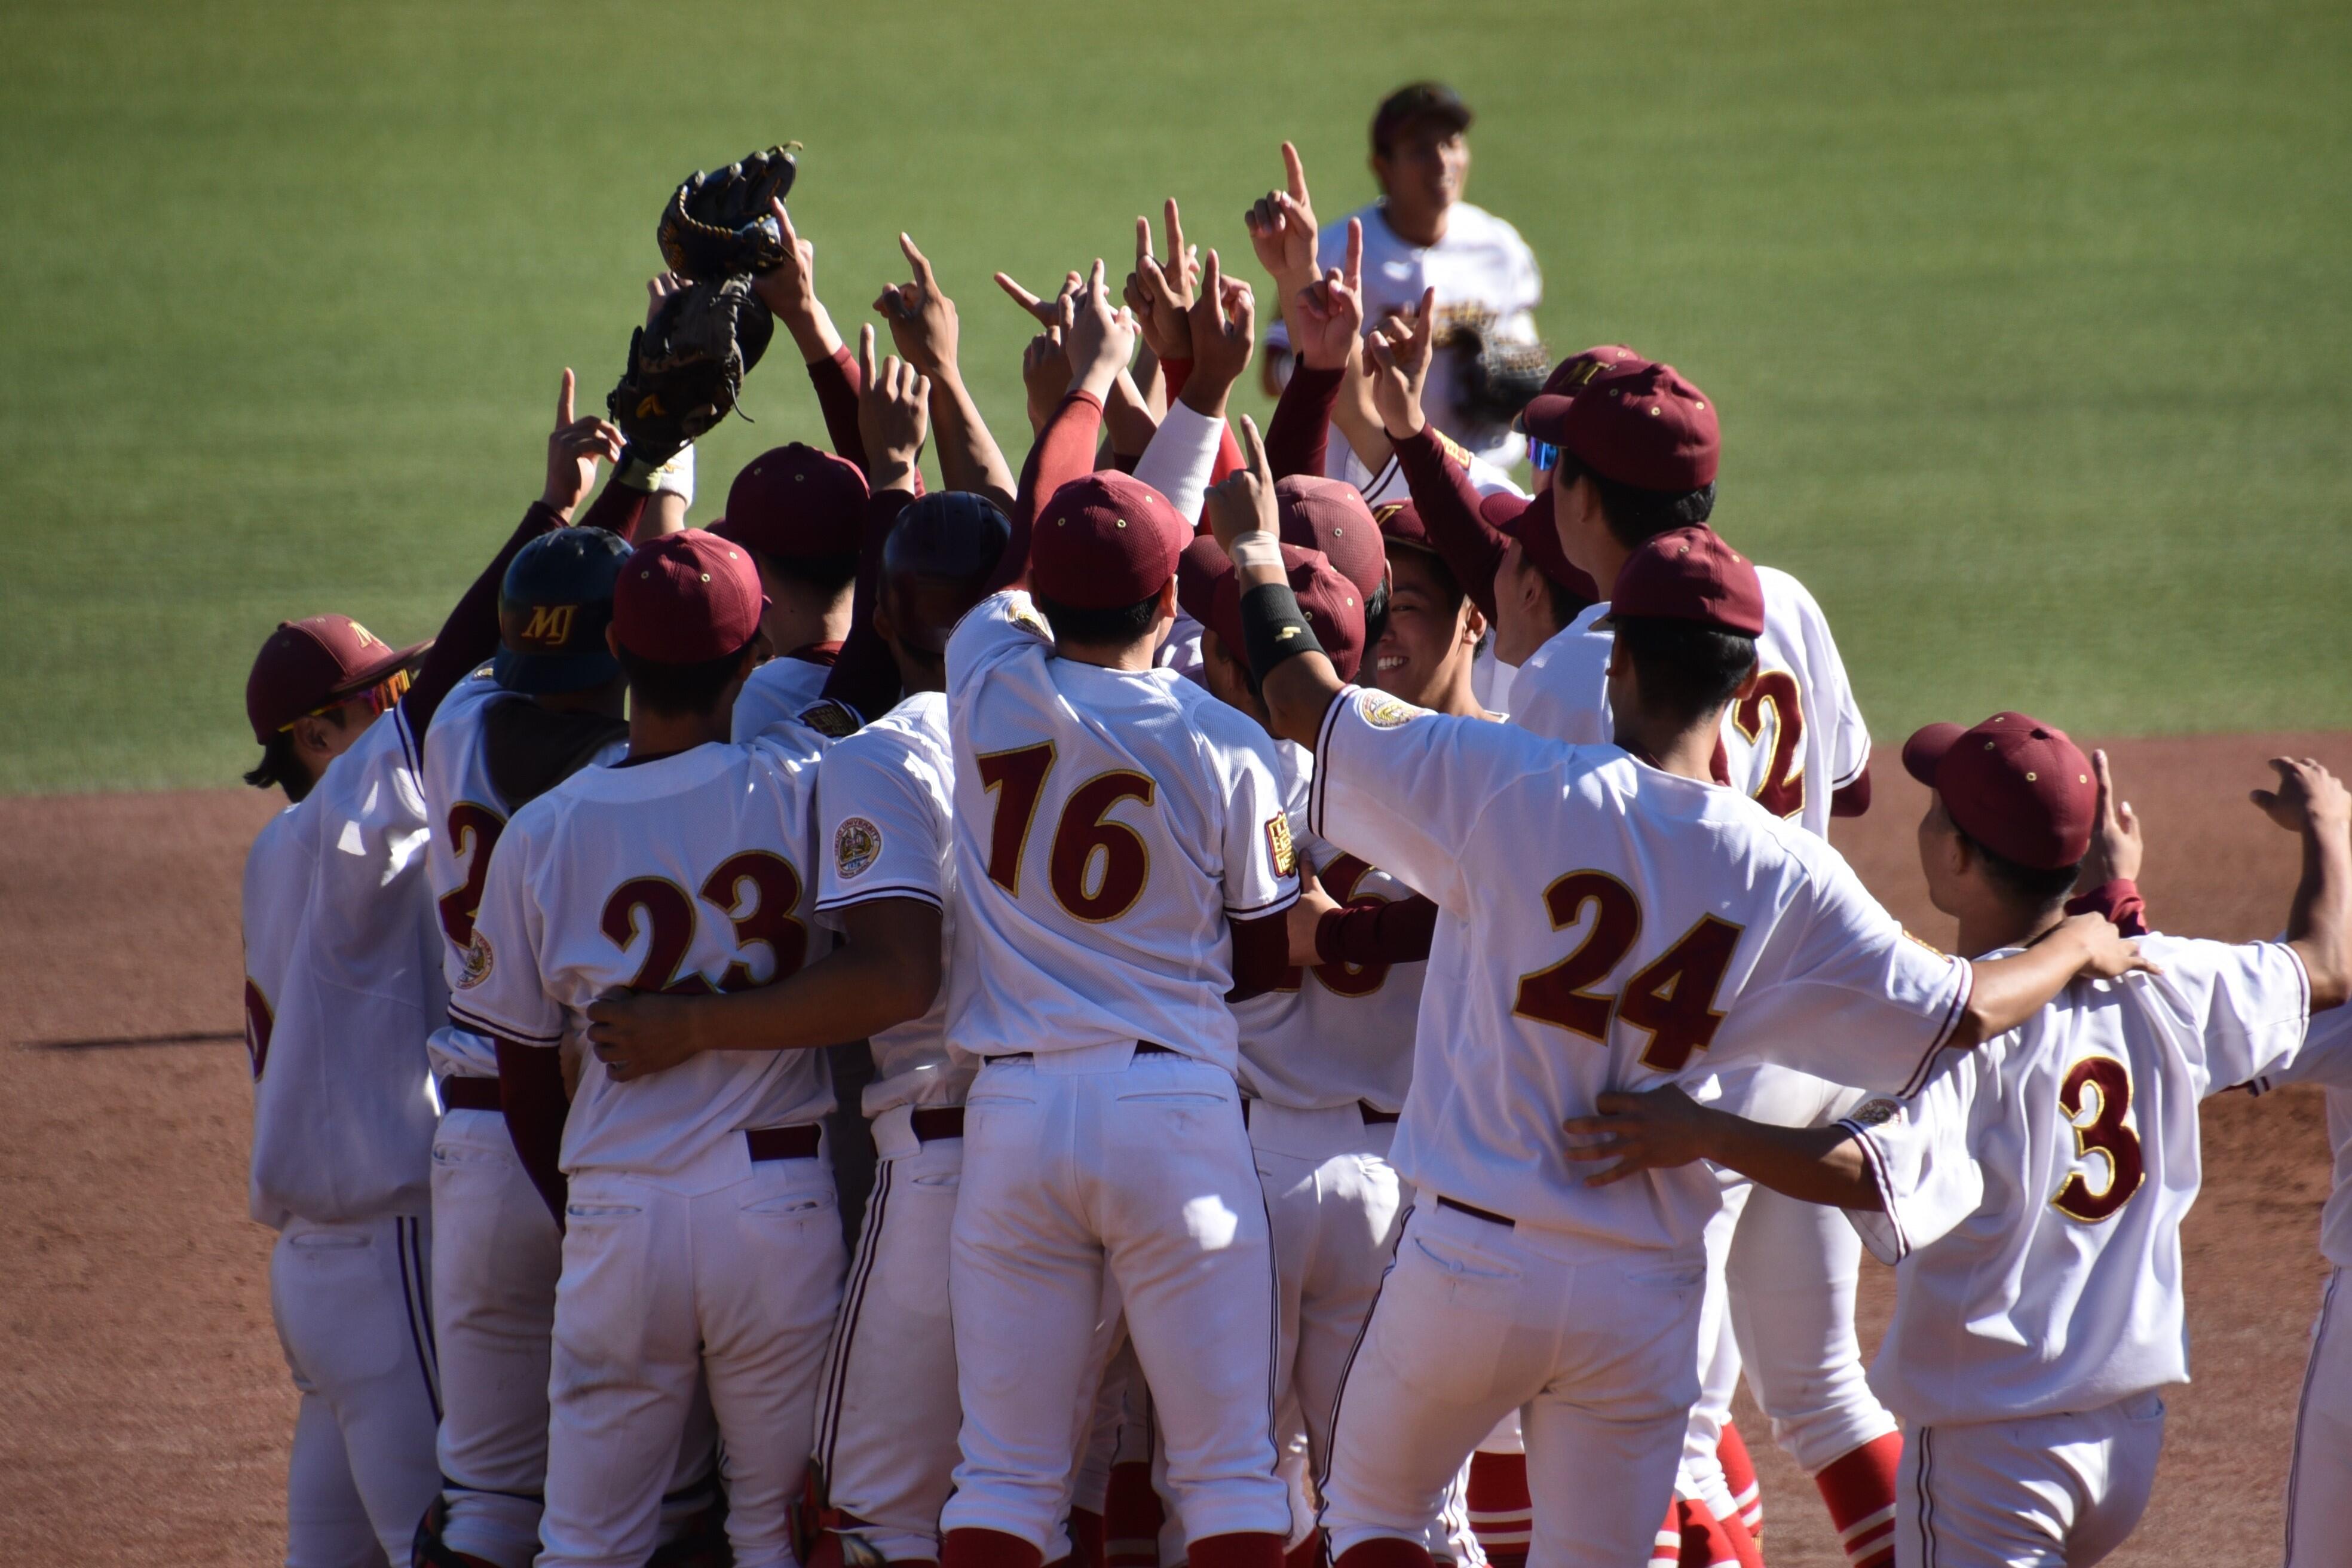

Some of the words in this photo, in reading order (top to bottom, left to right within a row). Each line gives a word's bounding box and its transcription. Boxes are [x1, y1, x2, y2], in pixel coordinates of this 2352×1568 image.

[521, 604, 578, 645] MJ
[976, 739, 1156, 924] 16
[601, 849, 808, 995] 23
[1511, 868, 1746, 1073] 24
[2050, 1055, 2146, 1224] 3
